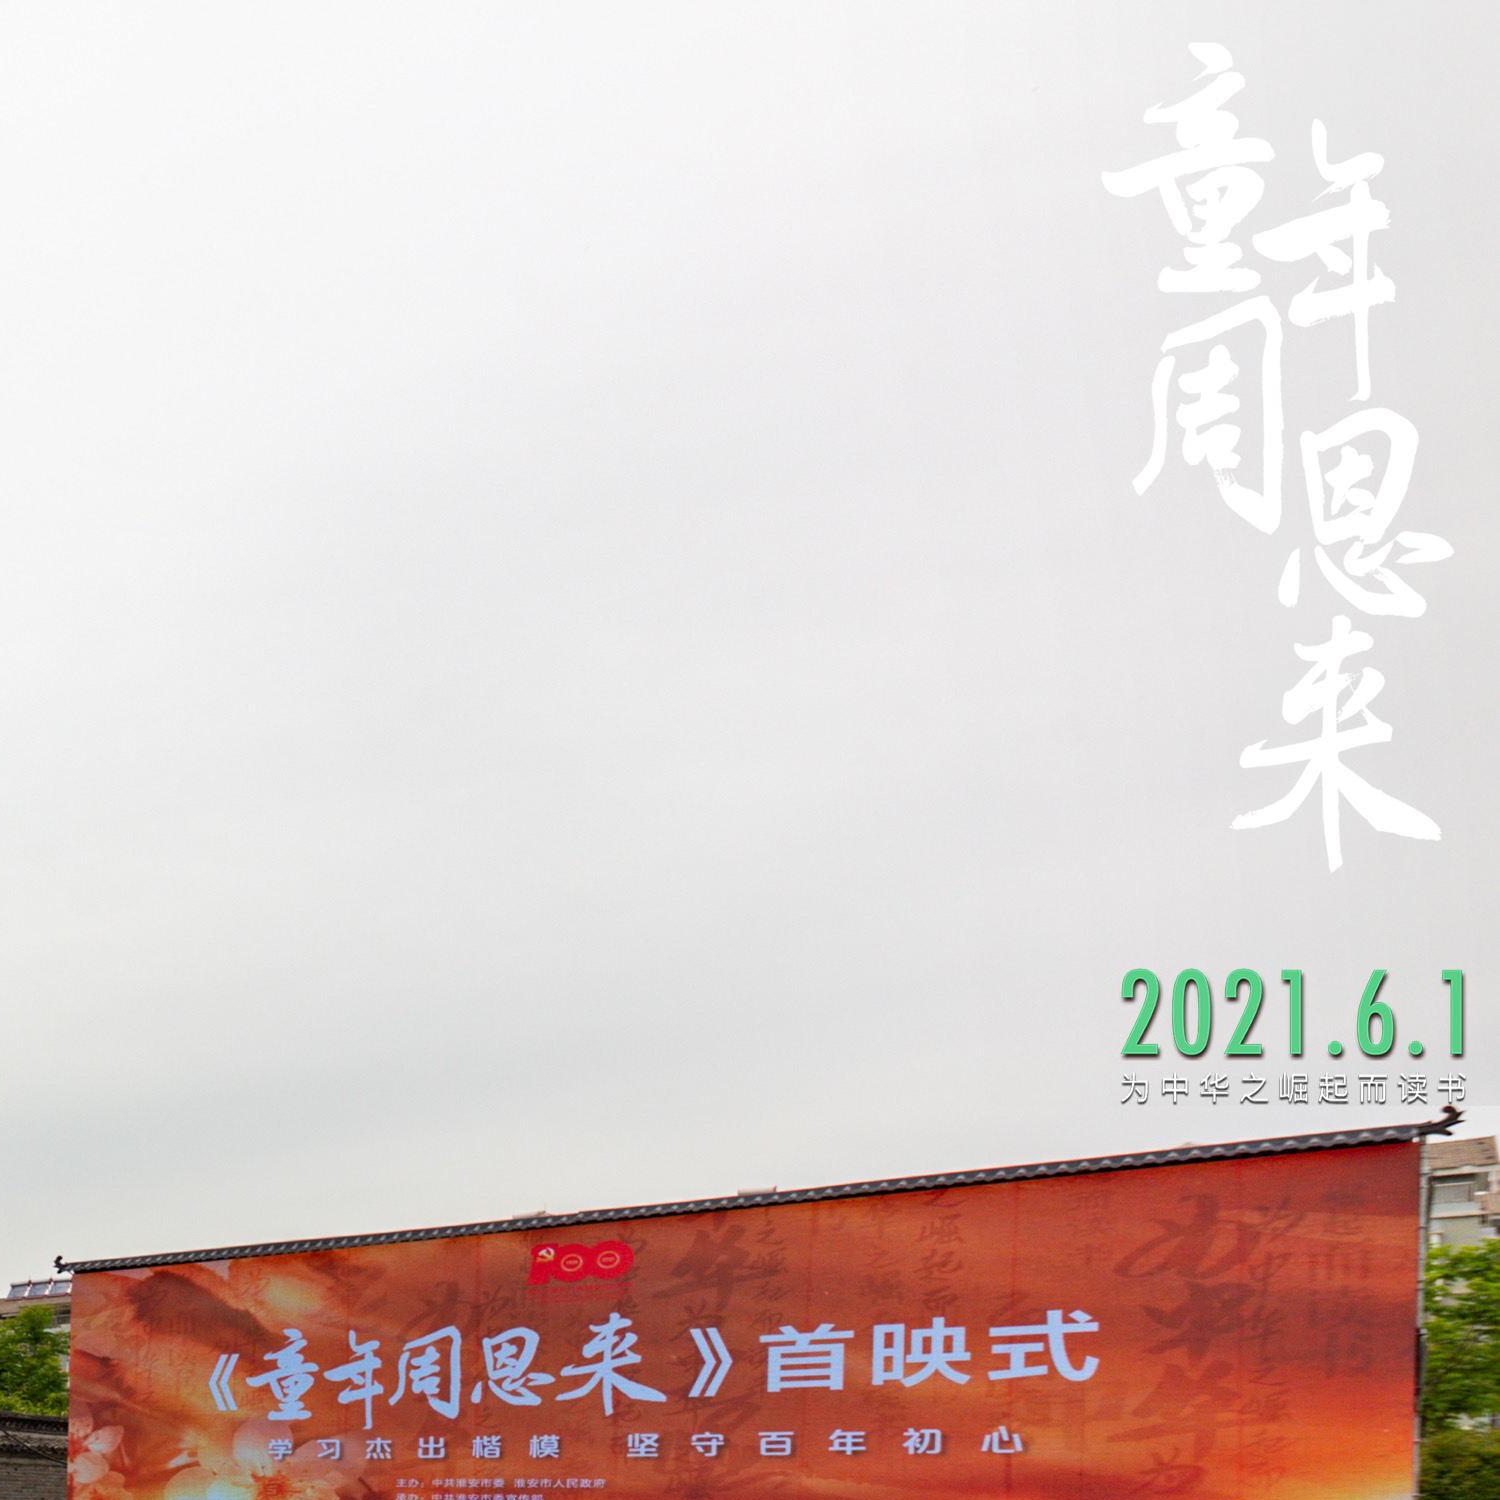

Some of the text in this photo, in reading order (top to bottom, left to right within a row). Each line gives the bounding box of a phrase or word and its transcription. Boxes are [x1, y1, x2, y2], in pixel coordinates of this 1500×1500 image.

[267, 1425, 1024, 1461] 学习杰出楷模 坚守百年初心
[513, 1478, 607, 1489] 淮安市人民政府
